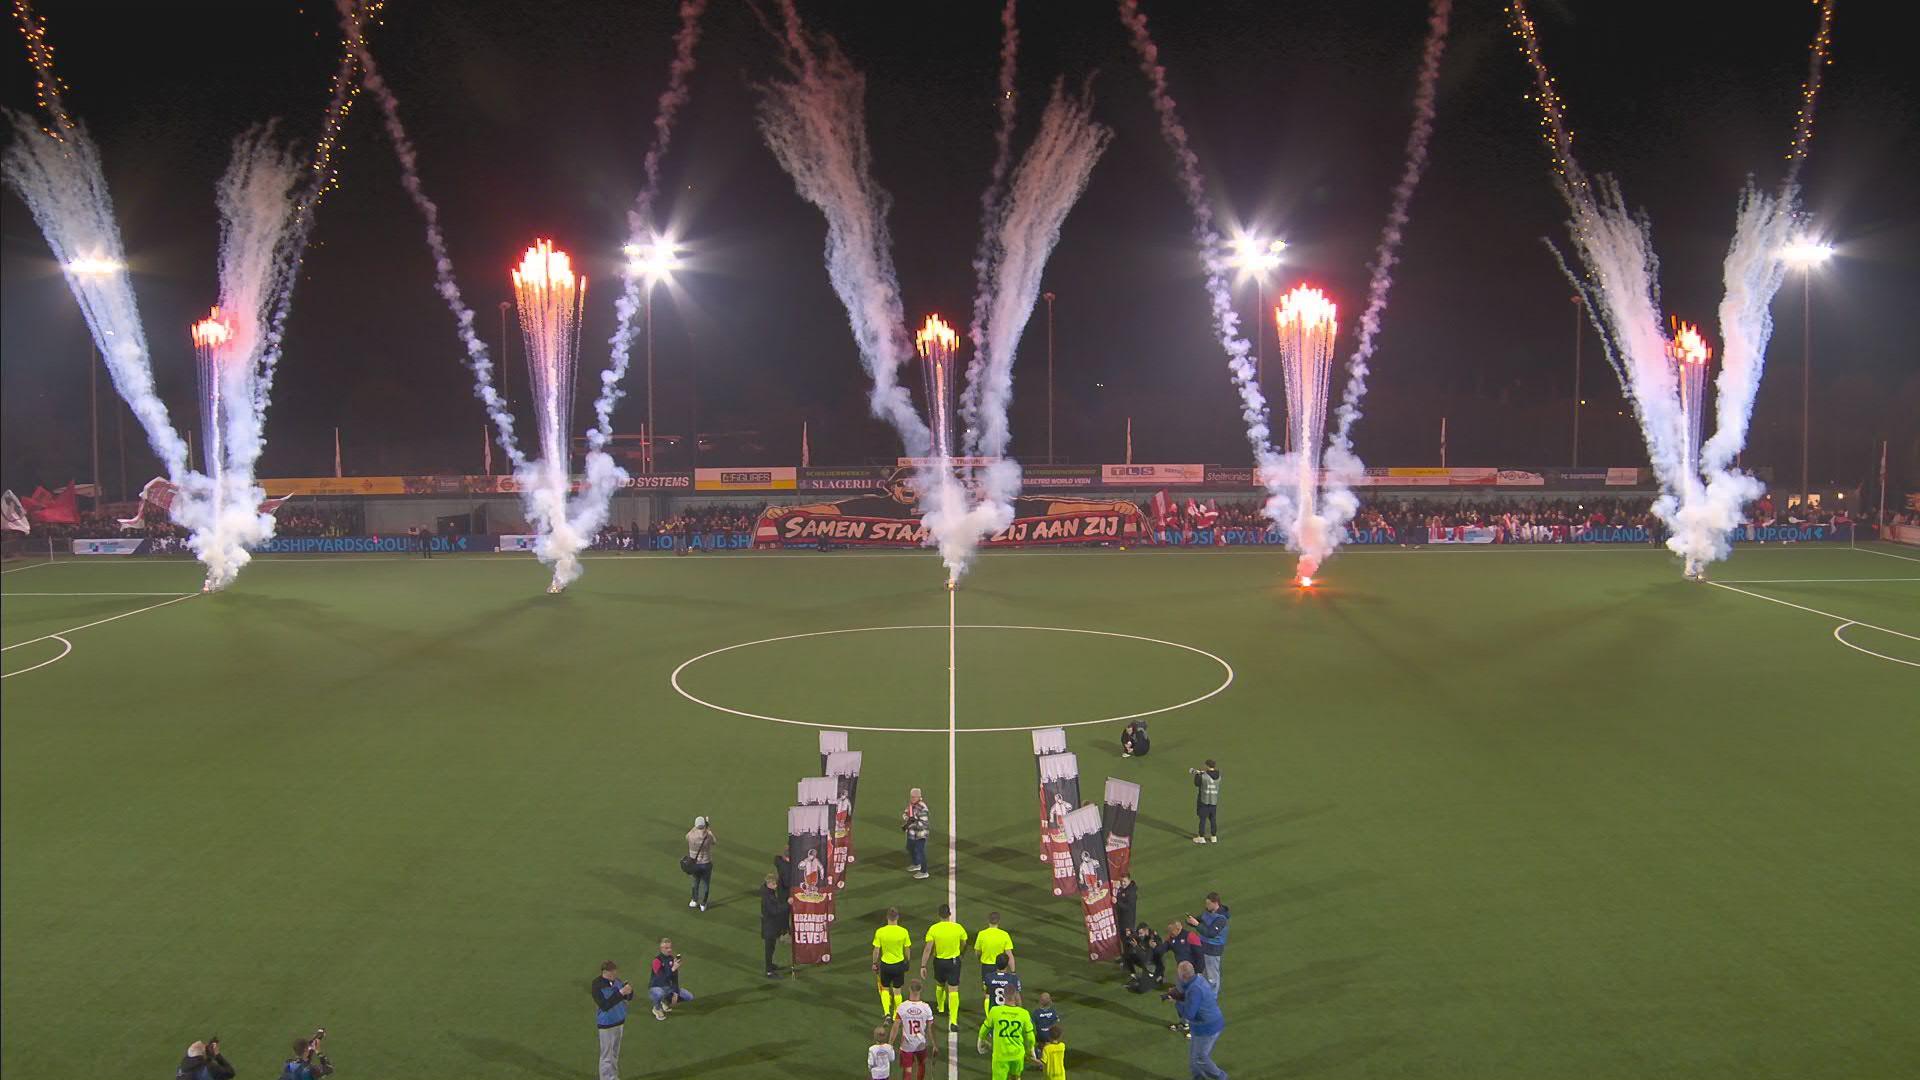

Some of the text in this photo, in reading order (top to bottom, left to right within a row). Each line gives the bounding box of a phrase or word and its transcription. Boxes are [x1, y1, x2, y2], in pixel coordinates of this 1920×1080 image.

[1111, 467, 1154, 476] TLS
[637, 476, 689, 487] SYSTEMS
[812, 479, 871, 489] SLAGERIJ
[785, 516, 866, 538] SAMEN
[869, 522, 930, 541] STAA
[1032, 518, 1079, 540] AAN
[1083, 516, 1119, 536] ZIJ
[995, 988, 1006, 1006] 8
[908, 1020, 921, 1035] 12
[998, 1019, 1021, 1038] 22
